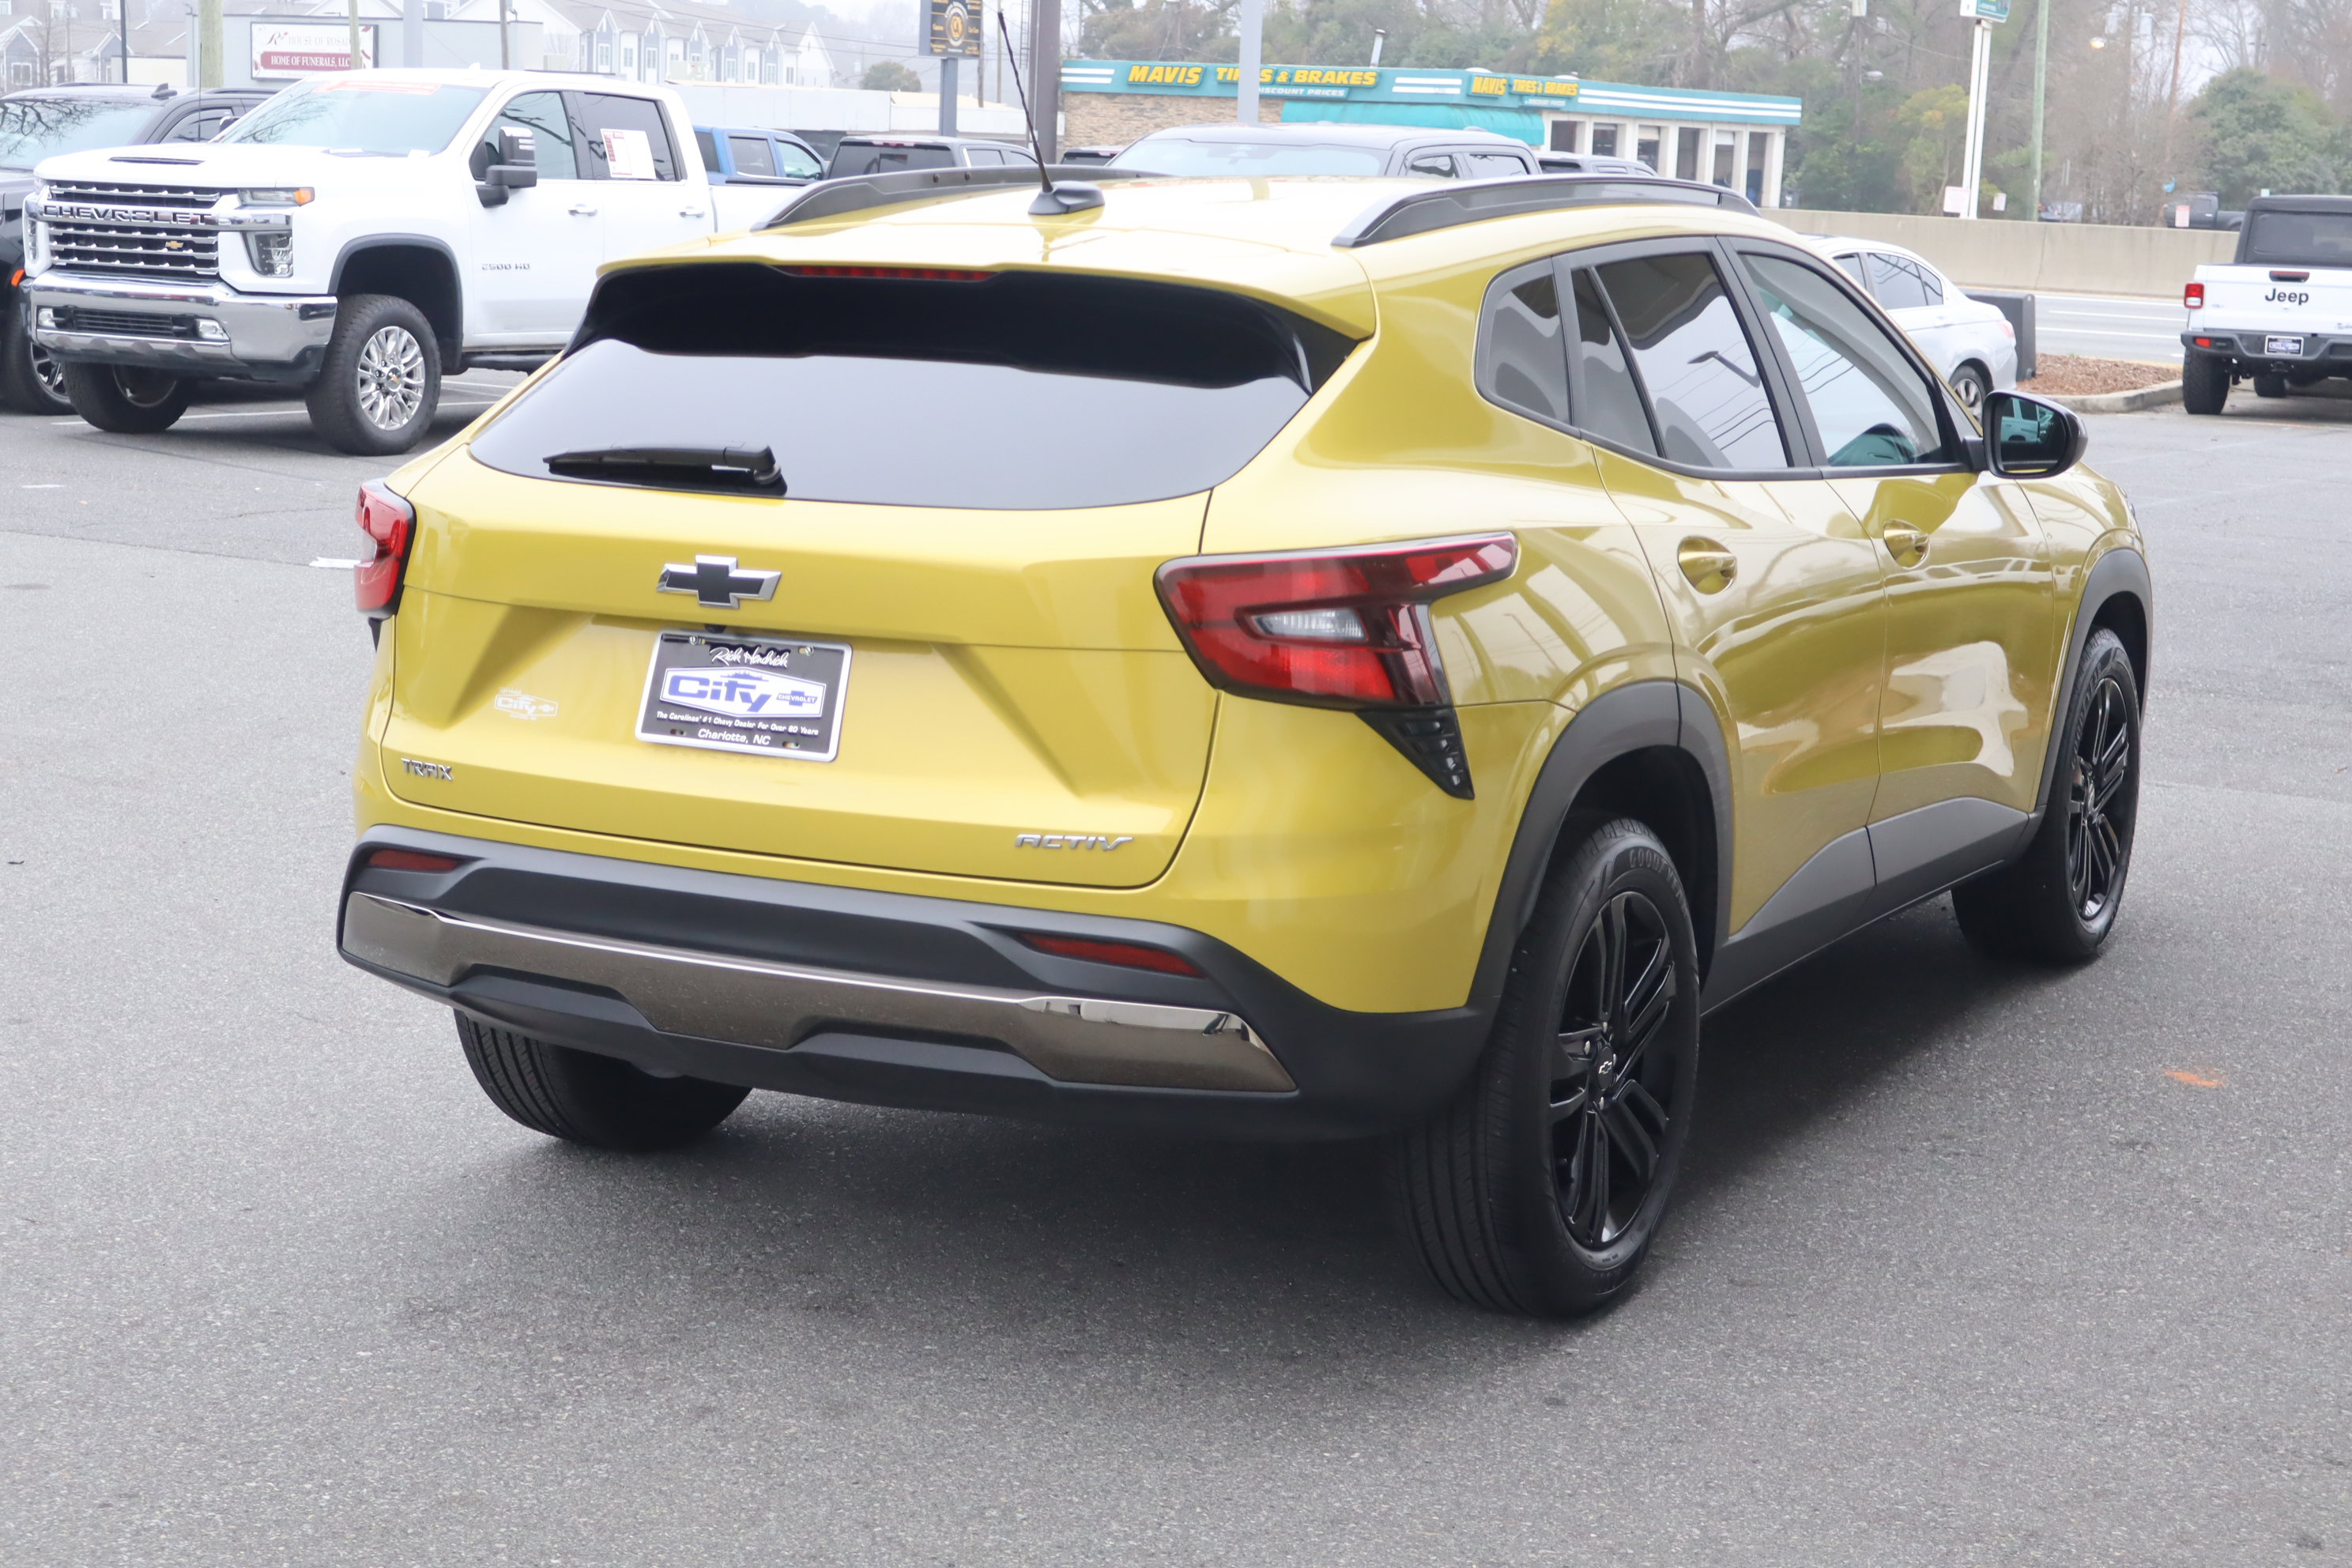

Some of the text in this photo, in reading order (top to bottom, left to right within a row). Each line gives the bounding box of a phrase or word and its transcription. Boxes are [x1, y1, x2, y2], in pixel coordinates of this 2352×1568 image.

[315, 36, 323, 45] OF
[270, 55, 291, 66] HOME
[291, 55, 301, 66] OF
[302, 56, 337, 68] FUNERALS,
[1128, 65, 1378, 86] MAVIS TIS & BRAKES
[1307, 88, 1346, 96] PRICES
[1472, 76, 1508, 96] MAVIS
[43, 205, 214, 225] CHEVROLET
[2264, 288, 2309, 306] Jeep
[710, 646, 790, 668] Rick Hendrick
[668, 674, 816, 713] City CHEVROLET
[497, 697, 537, 714] City
[657, 710, 668, 719] The
[669, 712, 702, 722] Carolinas'
[713, 717, 733, 727] Chevy
[733, 719, 756, 729] Dealer
[757, 722, 770, 730] For
[770, 723, 786, 732] Over
[800, 726, 819, 736] Years
[697, 728, 771, 745] Charlotte, NC
[401, 757, 454, 782] TRAX
[1015, 834, 1134, 852] ACTIV
